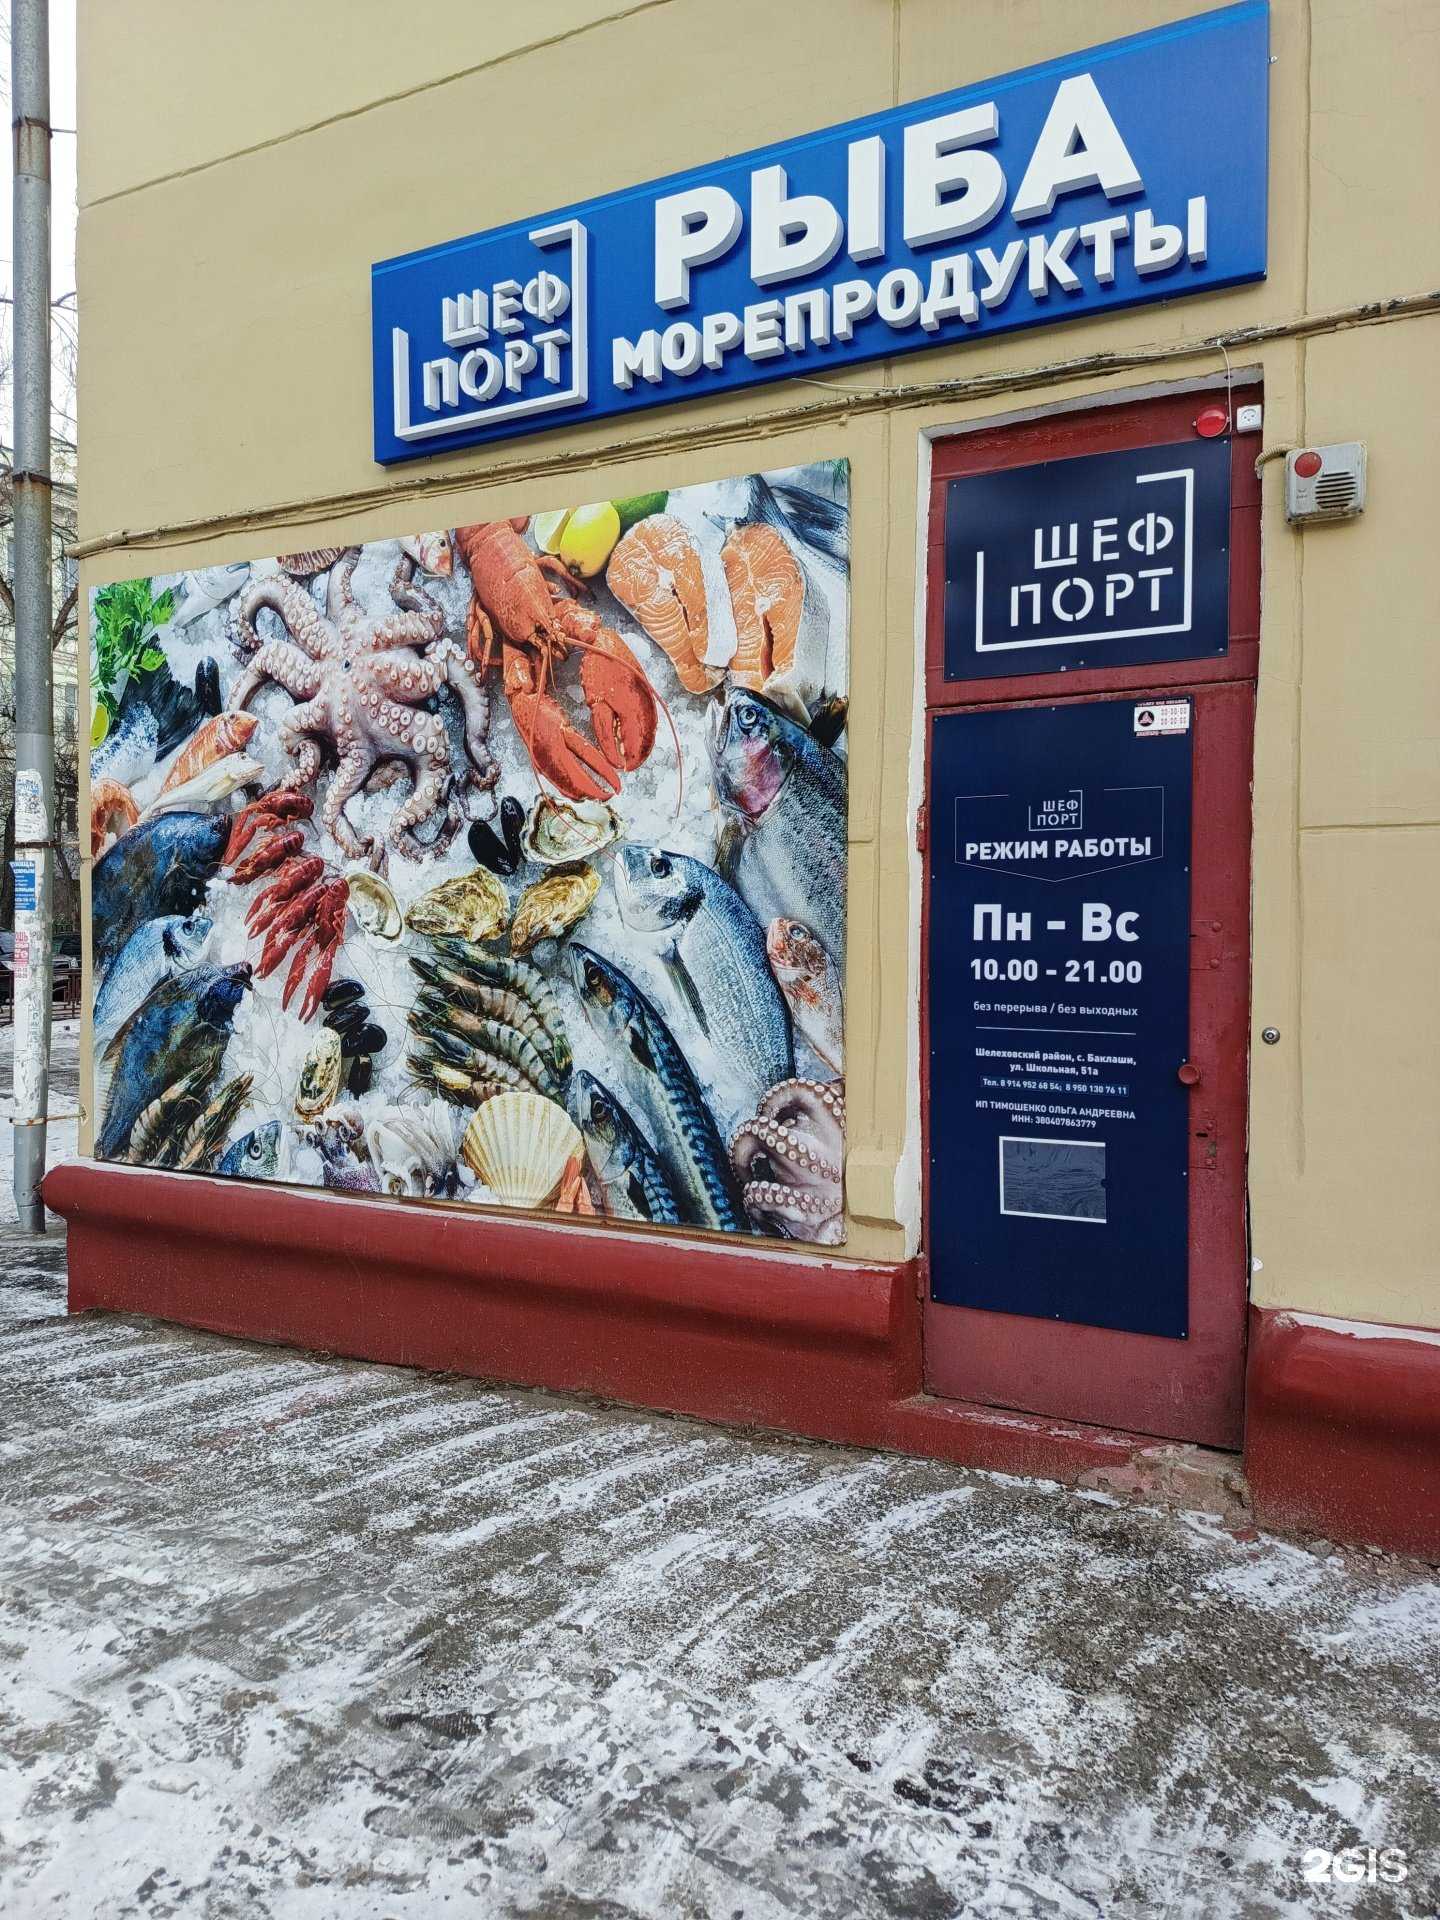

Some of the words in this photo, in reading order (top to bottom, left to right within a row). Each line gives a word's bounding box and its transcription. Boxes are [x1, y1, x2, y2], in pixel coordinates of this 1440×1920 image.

[653, 72, 1146, 311] РЫБА
[611, 195, 1207, 390] МОРЕПРОДУКТЫ
[442, 270, 571, 348] ШЕФ
[423, 328, 571, 411] ПОРТ
[1034, 512, 1174, 570] ШЕФ
[1010, 567, 1174, 627] ПОРТ
[1042, 799, 1079, 812] ШЕФ
[1036, 812, 1079, 826] ПОРТ
[965, 840, 1049, 861] РЕЖИМ
[1054, 836, 1152, 858] РАБОТЫ
[973, 903, 1032, 941] Пн
[1082, 902, 1141, 942] Вс
[970, 958, 1039, 982] 10.00
[1064, 959, 1143, 984] 21.00
[973, 1001, 992, 1012] без
[994, 1002, 1048, 1015] перерыва
[1057, 1003, 1077, 1015] без
[1079, 1007, 1139, 1017] выходных
[975, 1047, 1041, 1061] Шелеховский
[1042, 1051, 1075, 1063] район,
[1077, 1054, 1086, 1063] с.
[1087, 1053, 1137, 1066] Баклаши,
[1009, 1063, 1024, 1073] ул.
[1026, 1063, 1079, 1076] Школьная,
[1080, 1066, 1099, 1076] 51а
[982, 1078, 999, 1087] Тел.
[1006, 1079, 1022, 1088] 914
[1022, 1080, 1038, 1089] 952
[1072, 1083, 1088, 1093] 950
[1105, 1086, 1116, 1095] 76
[1118, 1087, 1128, 1095] 11
[975, 1100, 988, 1109] ИП
[989, 1101, 1047, 1113] ТИМОШЕНКО
[1048, 1105, 1077, 1116] ОЛЬГА
[1079, 1107, 1137, 1120] АНДРЕЕВНА
[1011, 1113, 1034, 1124] ИНН:
[1035, 1115, 1097, 1129] 380407863779
